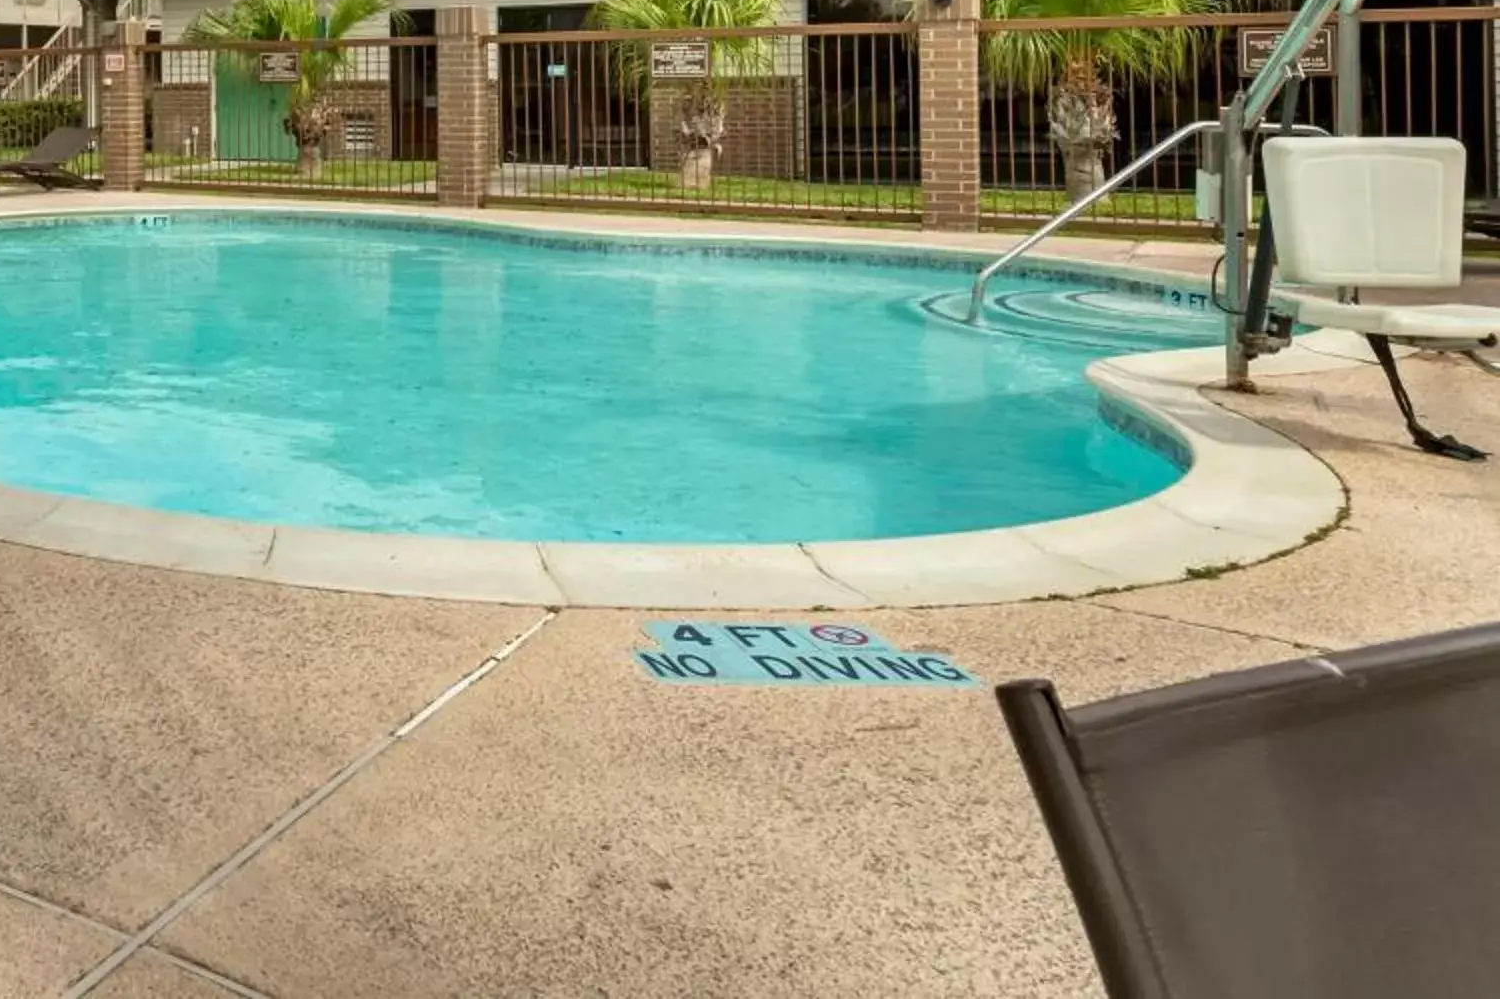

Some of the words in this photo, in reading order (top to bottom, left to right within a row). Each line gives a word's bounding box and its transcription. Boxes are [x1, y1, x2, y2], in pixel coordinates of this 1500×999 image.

[1188, 292, 1208, 310] FT
[673, 624, 713, 646] 4
[724, 625, 798, 648] FT
[638, 652, 717, 678] NO
[750, 654, 971, 681] DIVING
